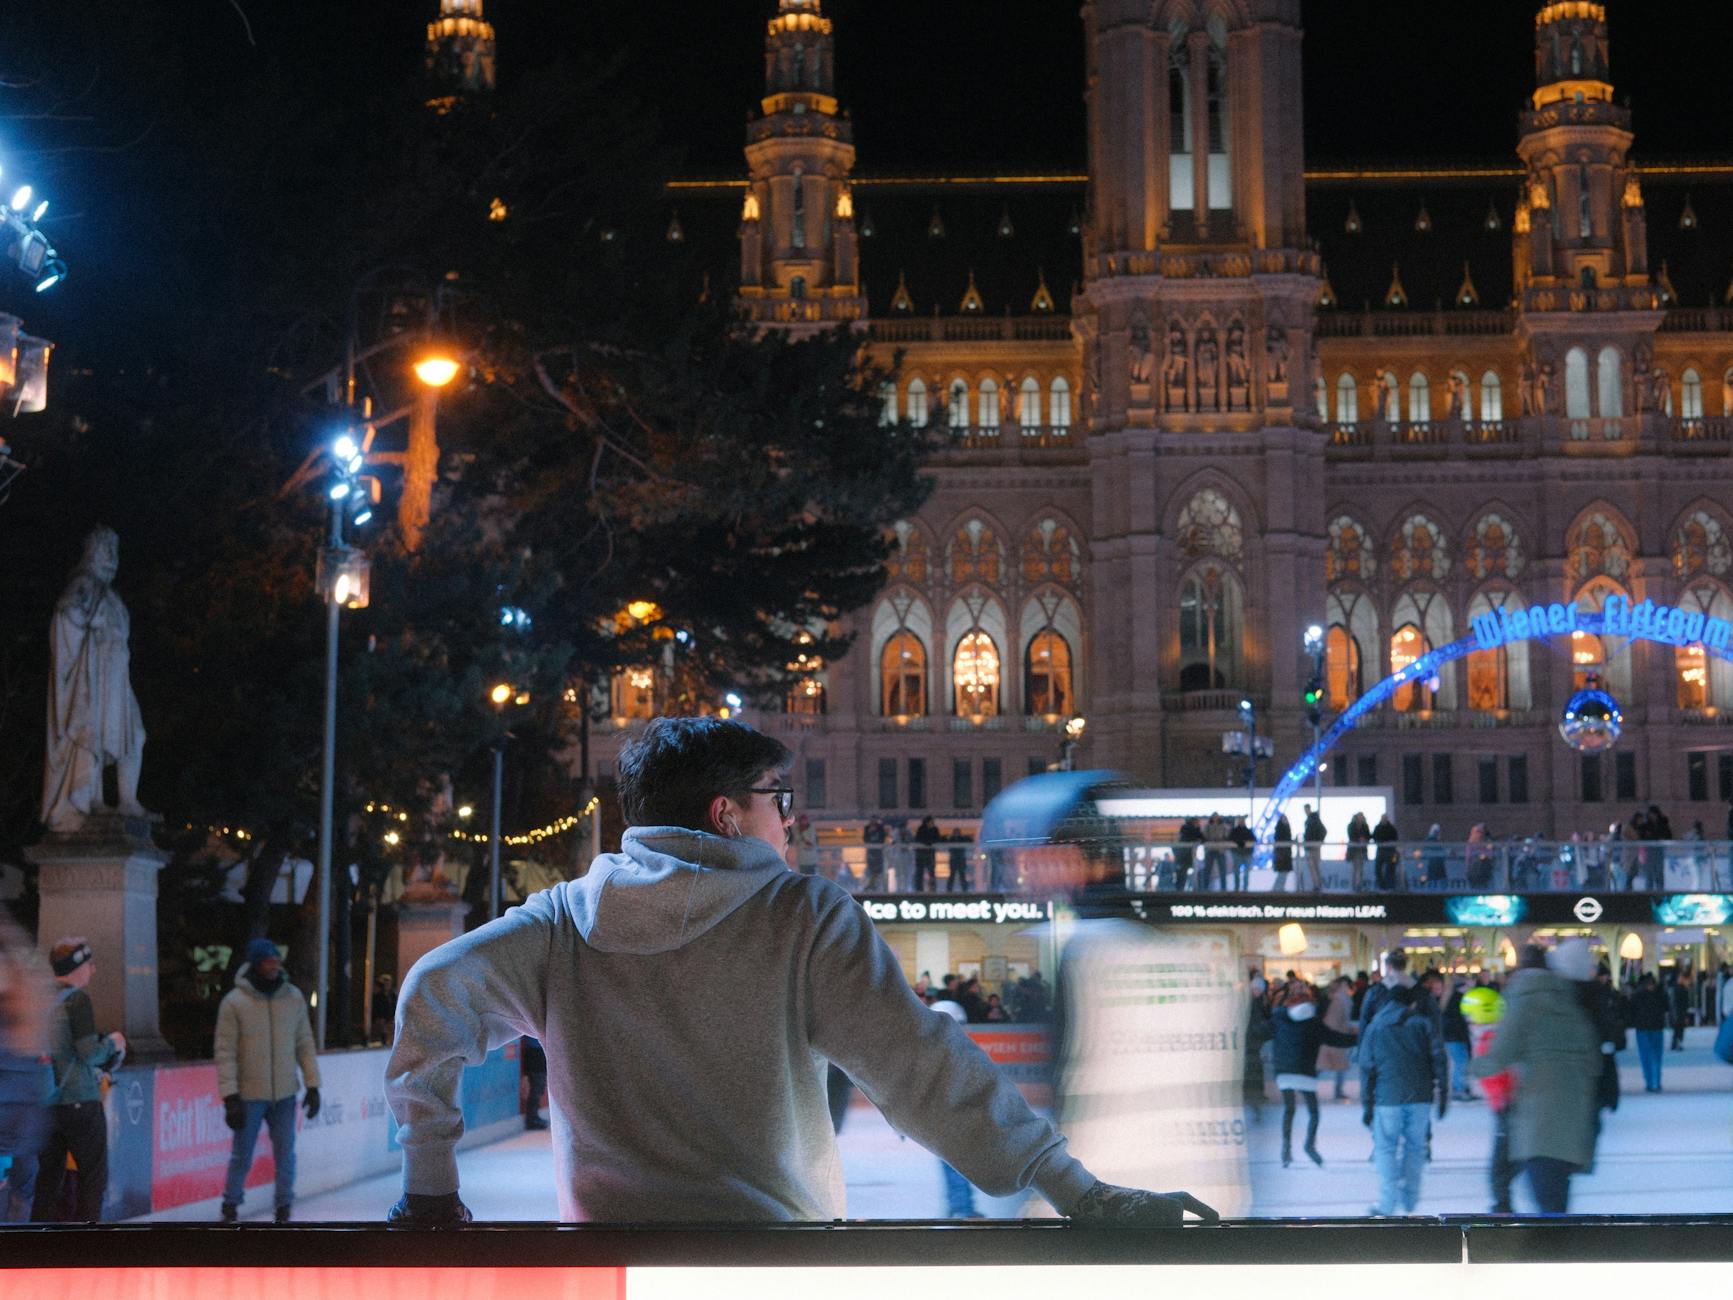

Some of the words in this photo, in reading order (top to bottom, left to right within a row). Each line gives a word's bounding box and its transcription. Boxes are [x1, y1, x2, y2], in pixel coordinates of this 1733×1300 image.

[1472, 602, 1578, 649] Wiener
[899, 900, 926, 919] to
[929, 900, 991, 919] meet
[993, 902, 1043, 923] you.
[1170, 905, 1192, 918] 100
[1194, 905, 1206, 918] %
[1207, 905, 1263, 918] elektrisch.
[1264, 905, 1285, 918] Der
[1286, 907, 1315, 918] neue
[1316, 905, 1354, 918] Nissan
[1355, 905, 1386, 918] LEAF.
